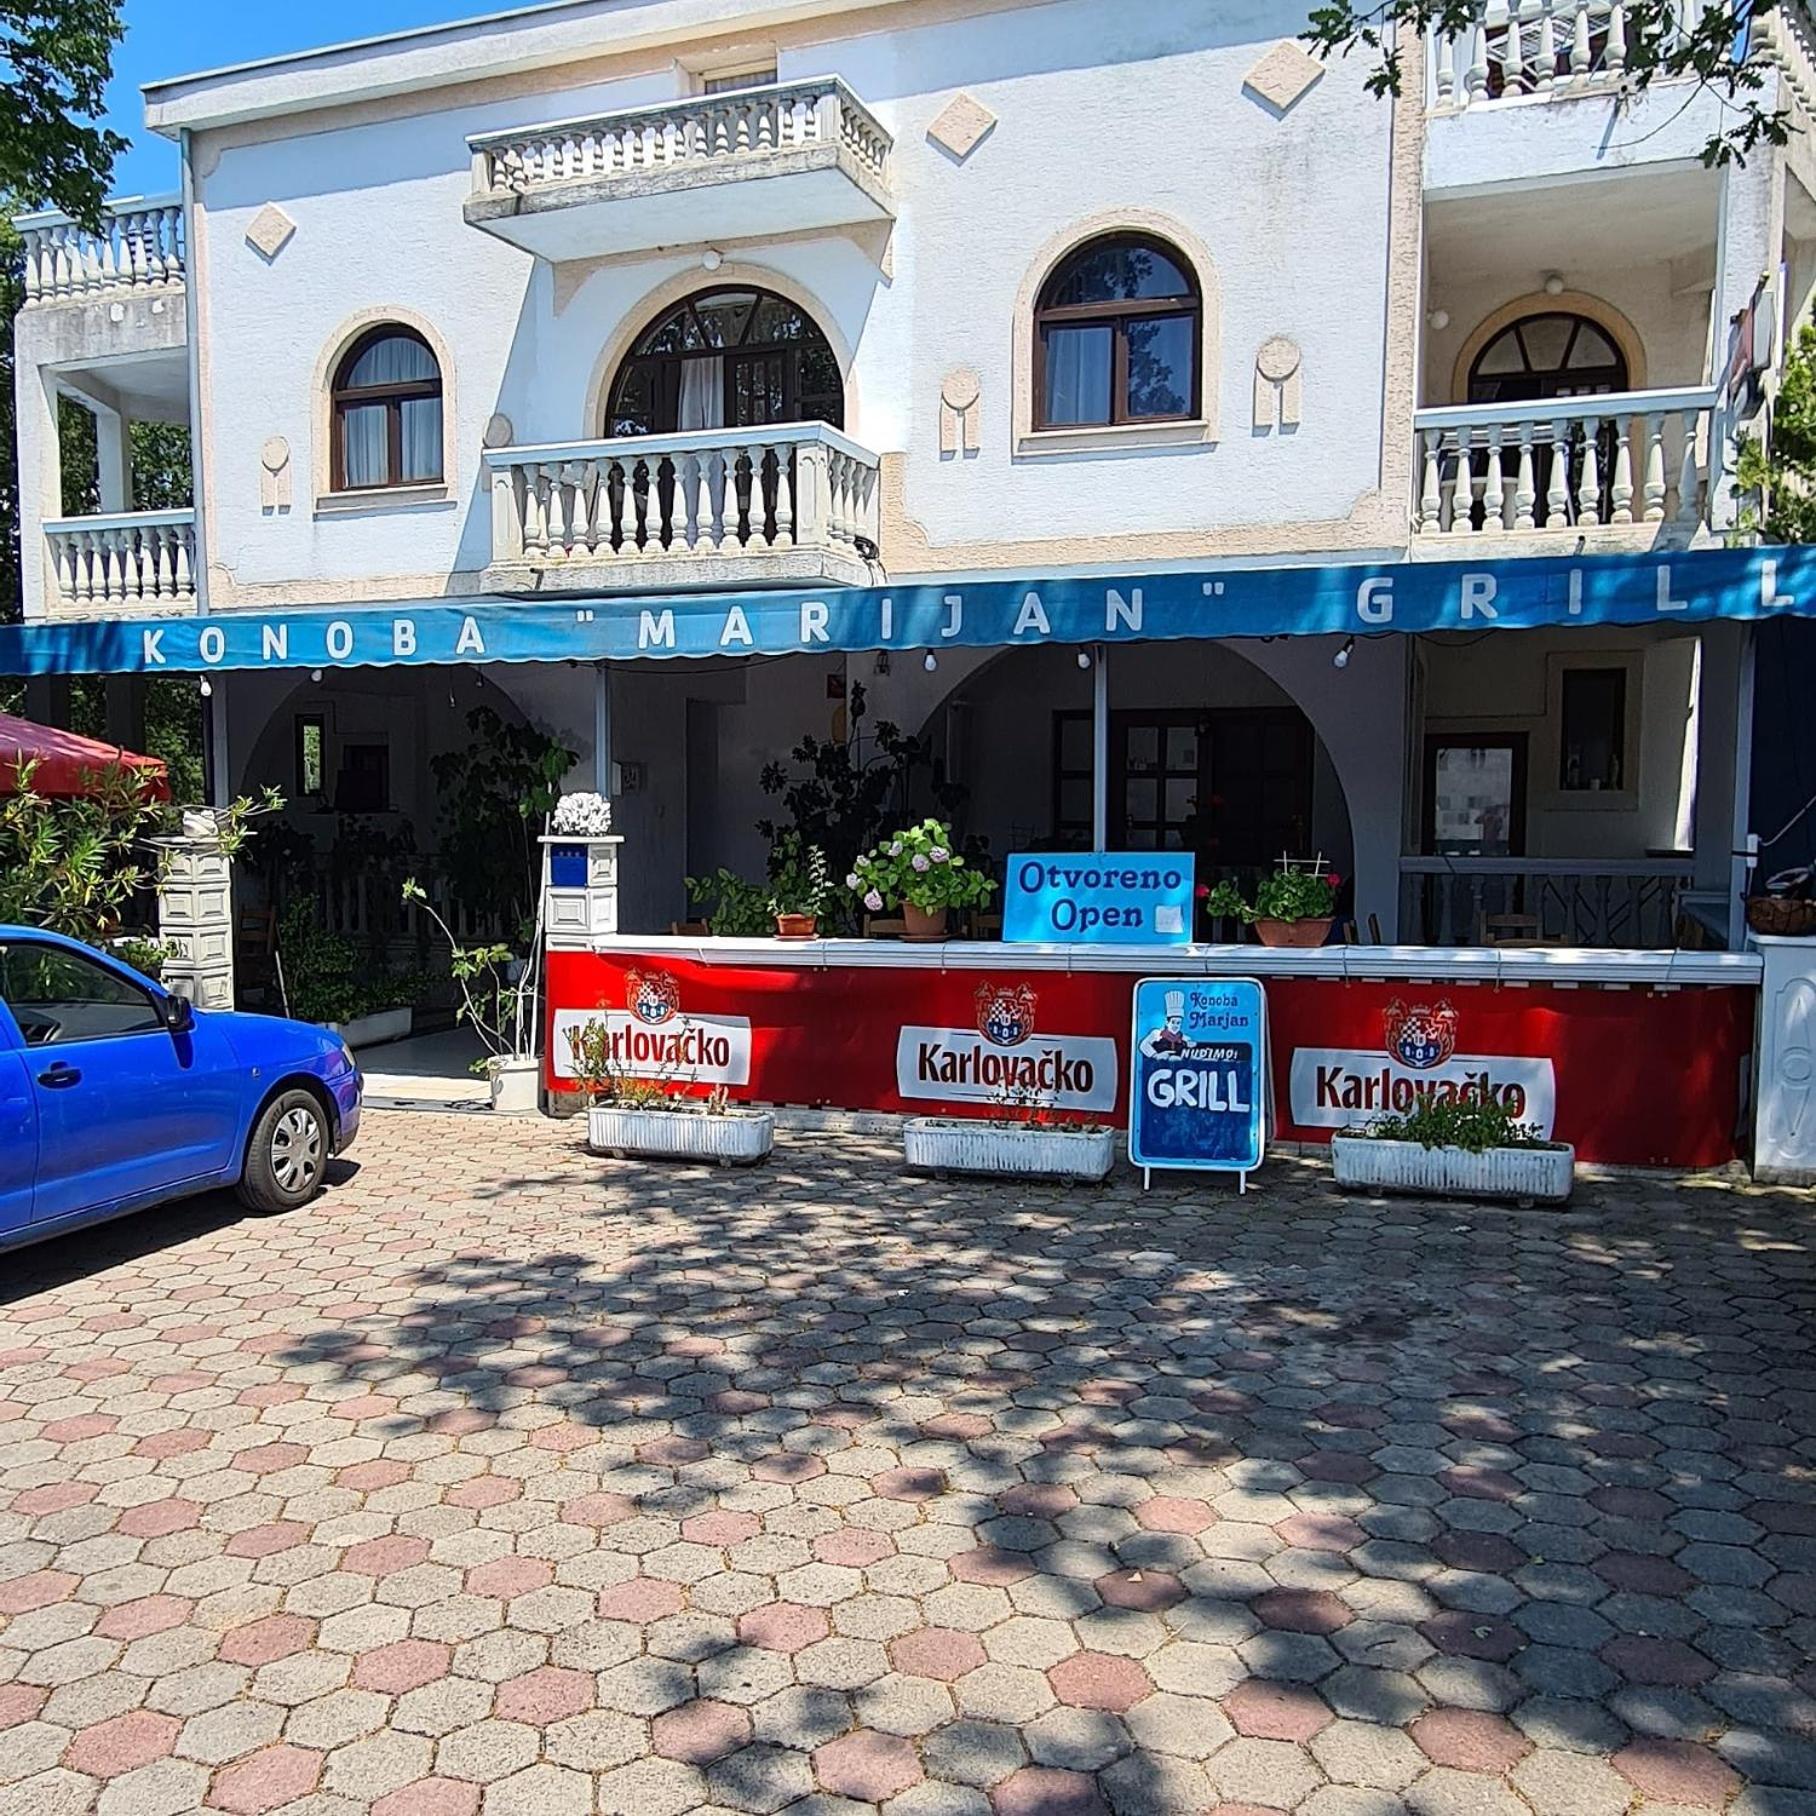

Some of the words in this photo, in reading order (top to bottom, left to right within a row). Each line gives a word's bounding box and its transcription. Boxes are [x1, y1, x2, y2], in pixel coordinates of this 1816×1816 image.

[142, 615, 486, 665] KONOBA
[1357, 559, 1796, 624] GRILL
[1019, 861, 1182, 893] Otvoreno
[1051, 898, 1144, 933] Open
[1189, 992, 1238, 1010] Konoba
[1189, 1011, 1249, 1031] Marjan
[918, 1042, 1094, 1093] Karlovačko
[1147, 1069, 1250, 1113] GRILL
